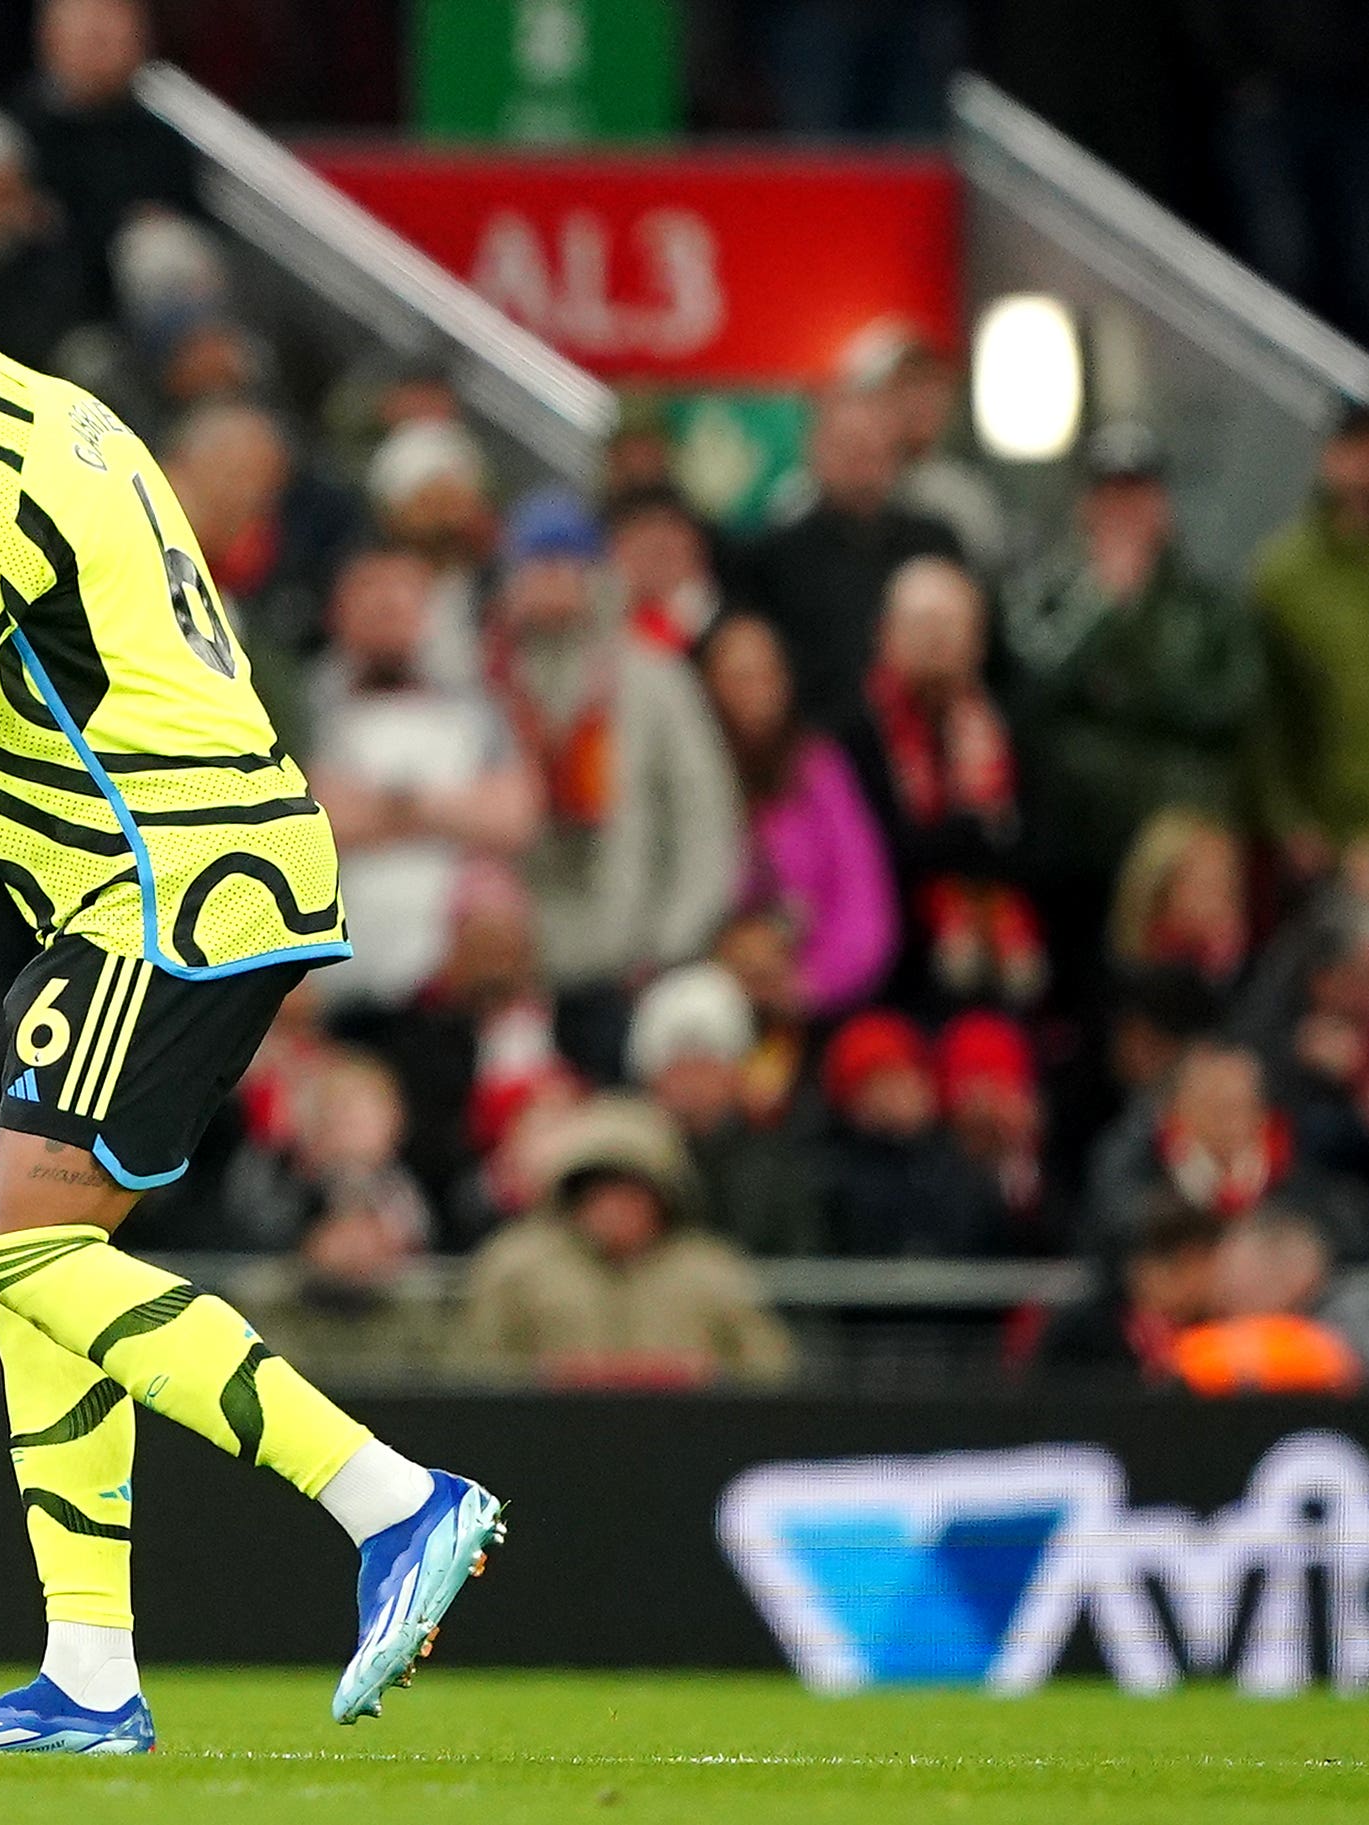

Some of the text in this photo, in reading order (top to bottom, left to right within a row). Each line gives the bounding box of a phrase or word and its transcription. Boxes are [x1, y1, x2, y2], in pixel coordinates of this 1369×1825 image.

[473, 206, 723, 354] AL3
[68, 401, 134, 471] GABRIE
[132, 473, 235, 679] 6
[16, 977, 71, 1068] 6
